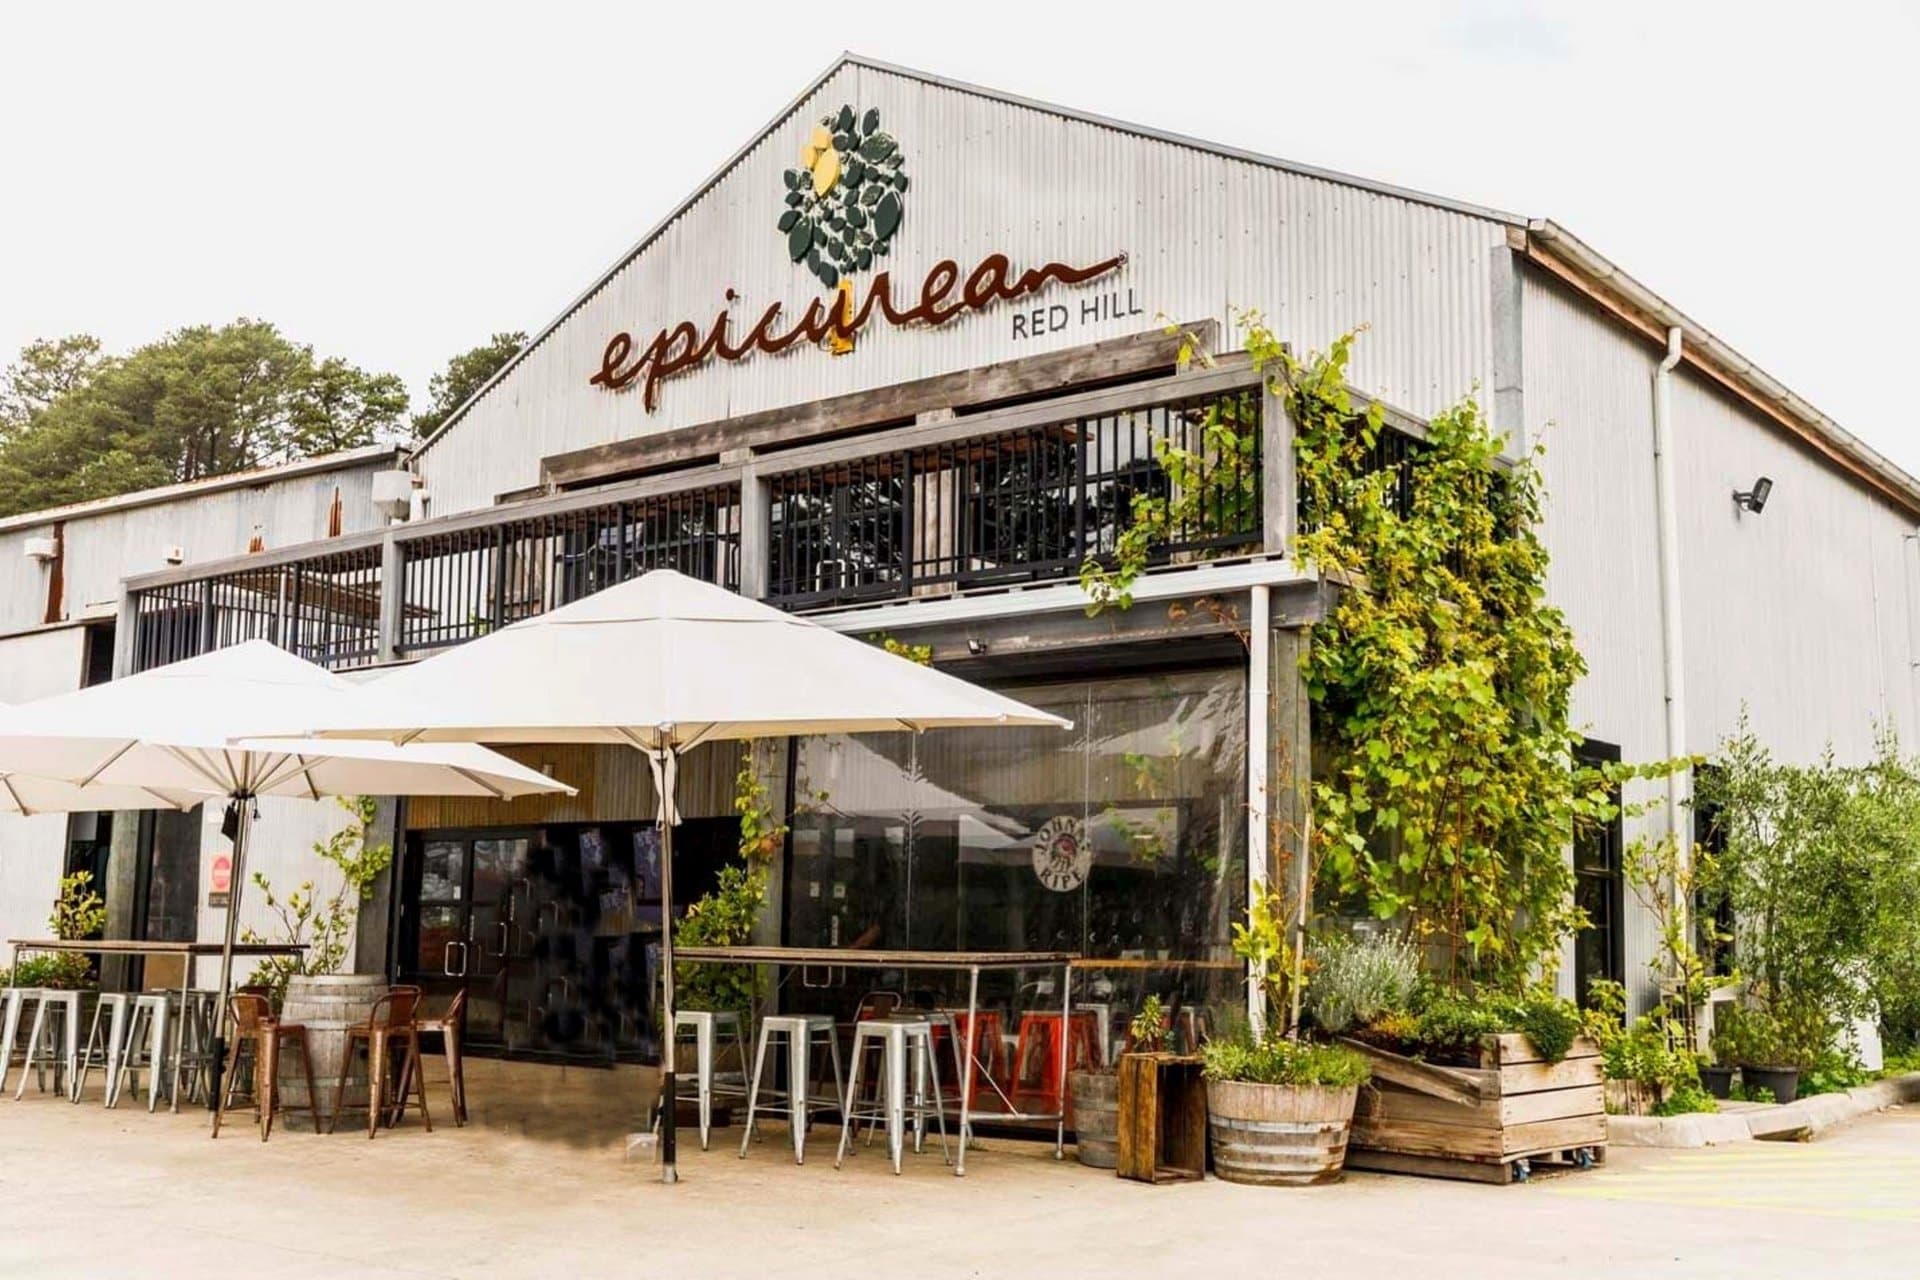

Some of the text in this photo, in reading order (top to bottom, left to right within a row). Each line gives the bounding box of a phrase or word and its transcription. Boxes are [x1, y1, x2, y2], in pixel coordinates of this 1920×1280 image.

[590, 251, 1125, 412] epicurean
[1012, 287, 1143, 341] RED HILL
